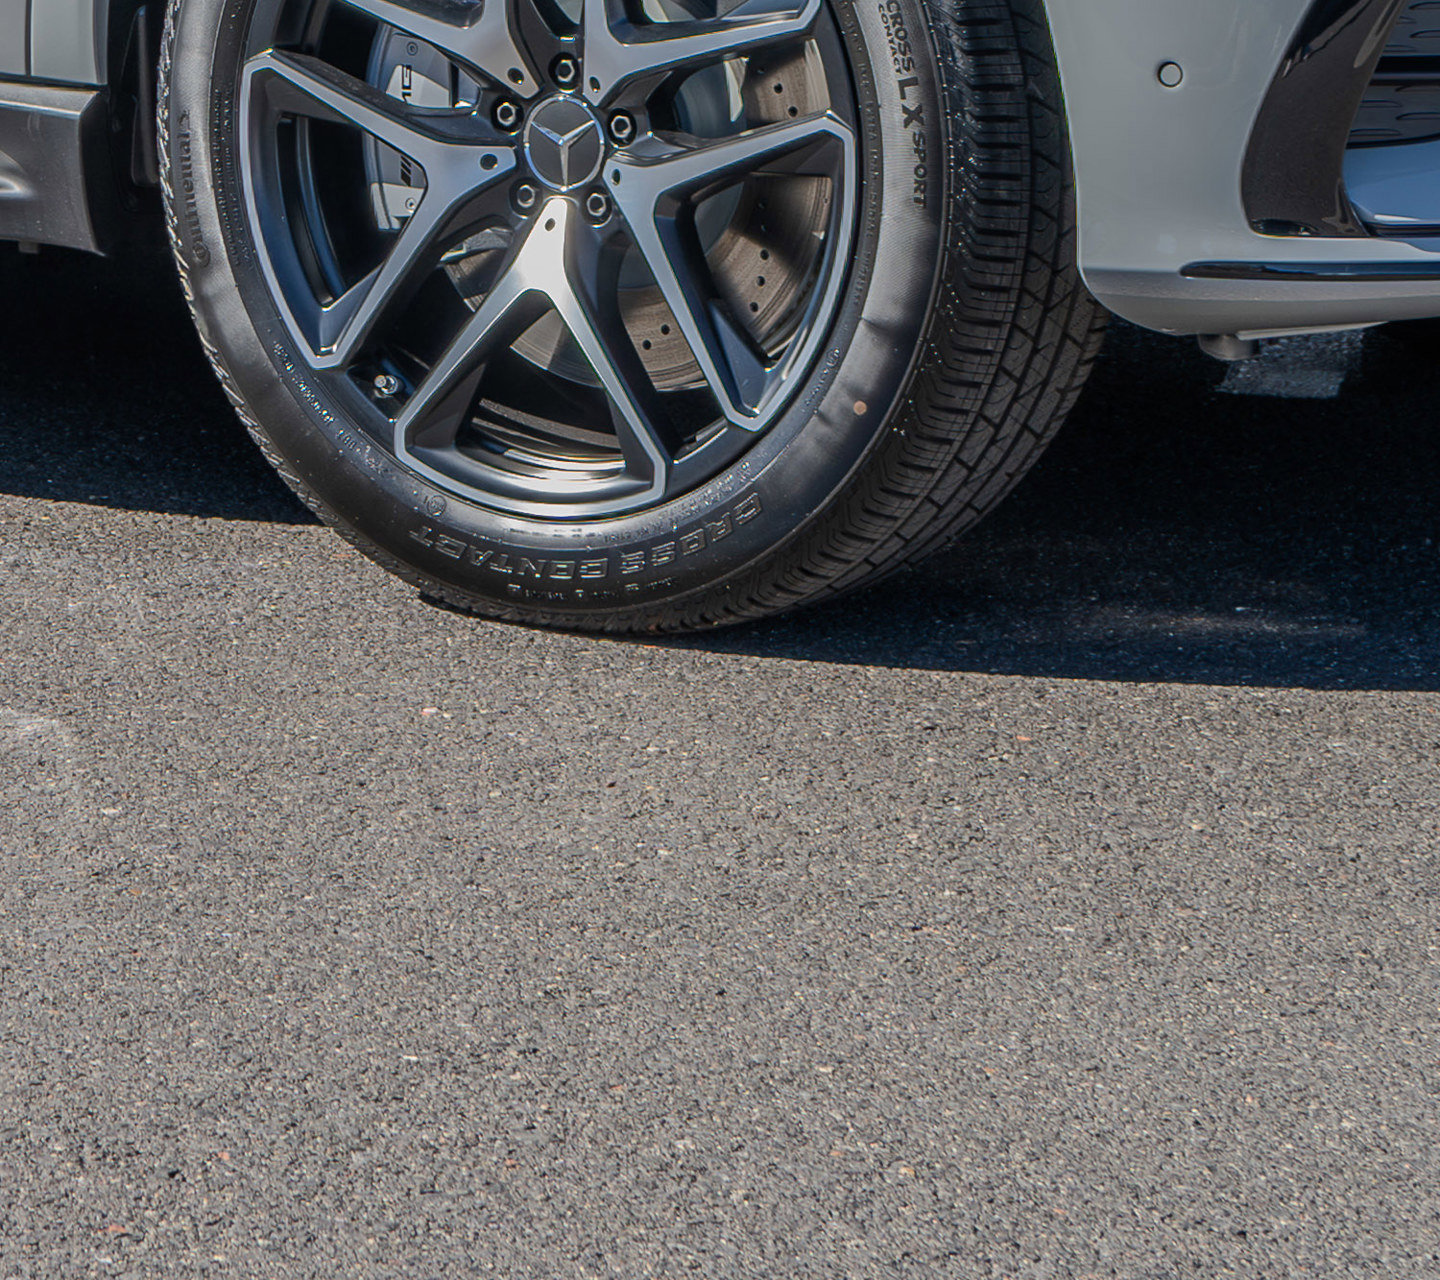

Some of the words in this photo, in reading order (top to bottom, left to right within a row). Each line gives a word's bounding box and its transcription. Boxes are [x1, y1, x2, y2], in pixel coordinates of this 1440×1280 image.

[878, 3, 902, 74] CONTACT
[898, 76, 925, 129] LX
[913, 130, 928, 209] SPORT
[621, 491, 764, 575] CROSS
